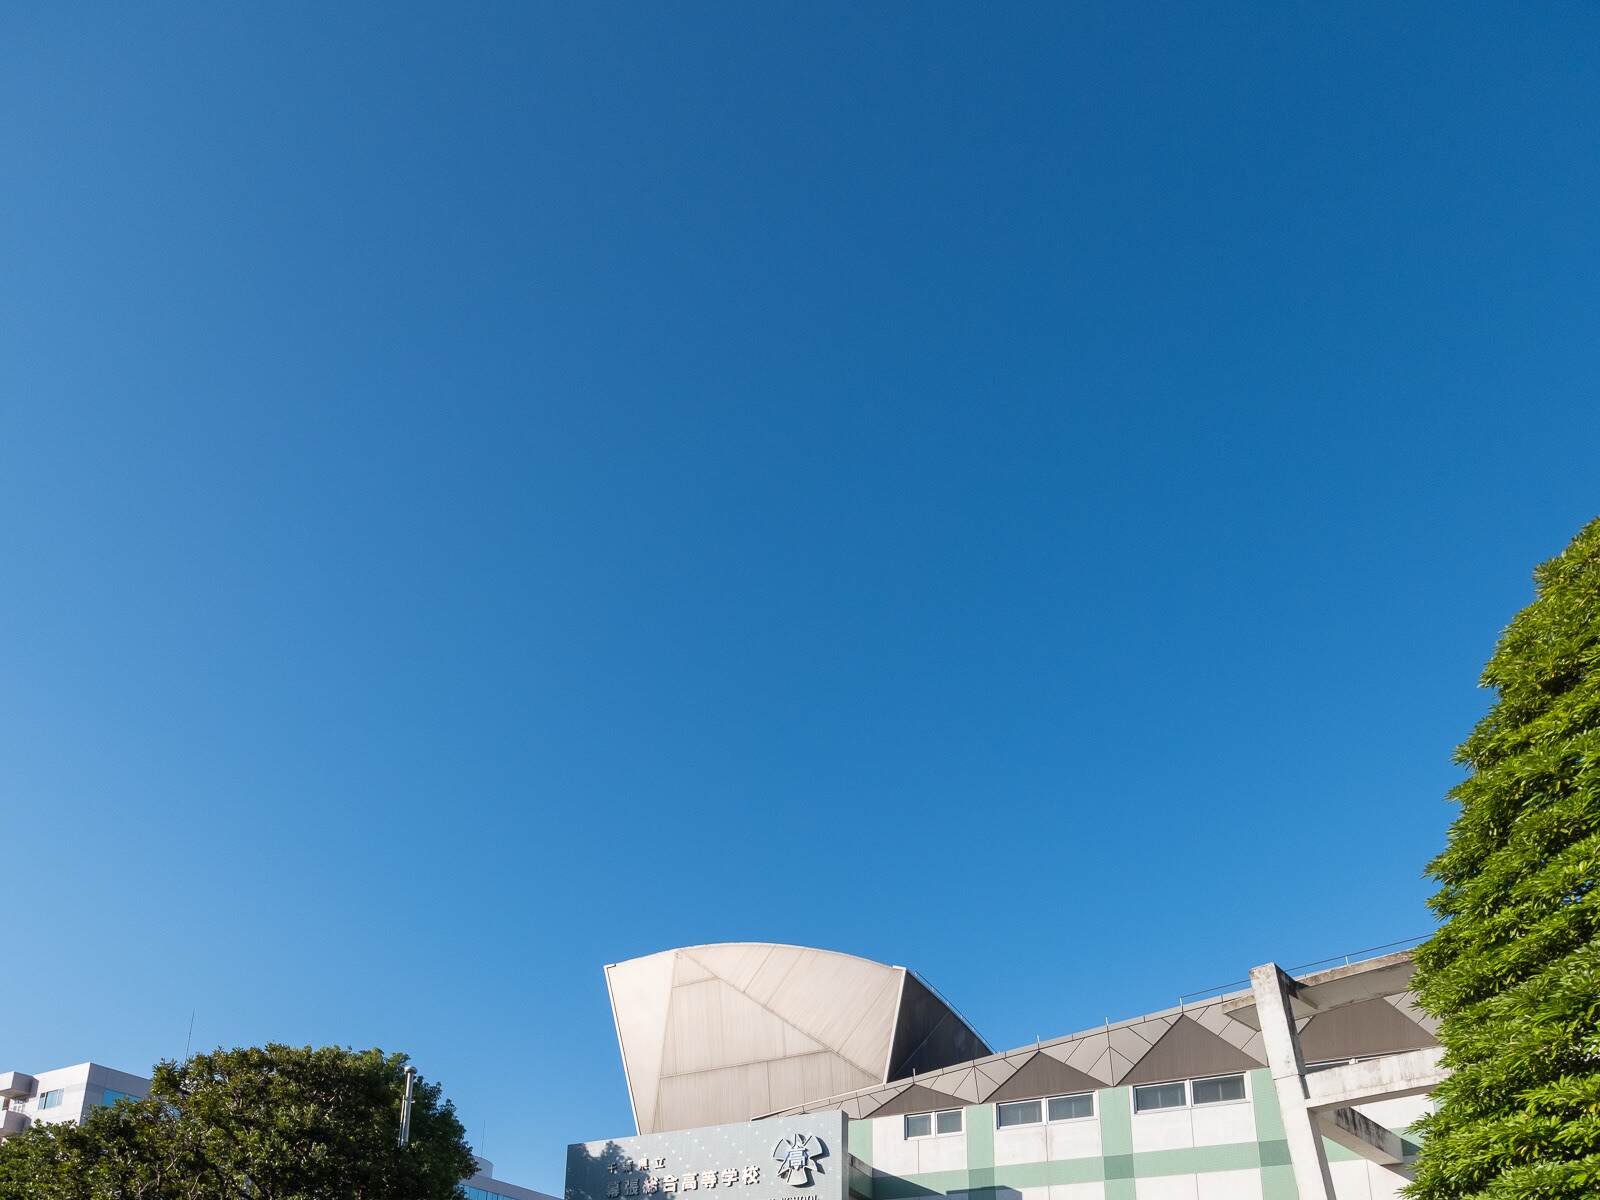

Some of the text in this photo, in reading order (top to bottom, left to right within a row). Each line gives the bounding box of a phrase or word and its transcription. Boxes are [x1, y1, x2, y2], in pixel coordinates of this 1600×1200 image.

[606, 1165, 761, 1199] 幕張総合高等学校
